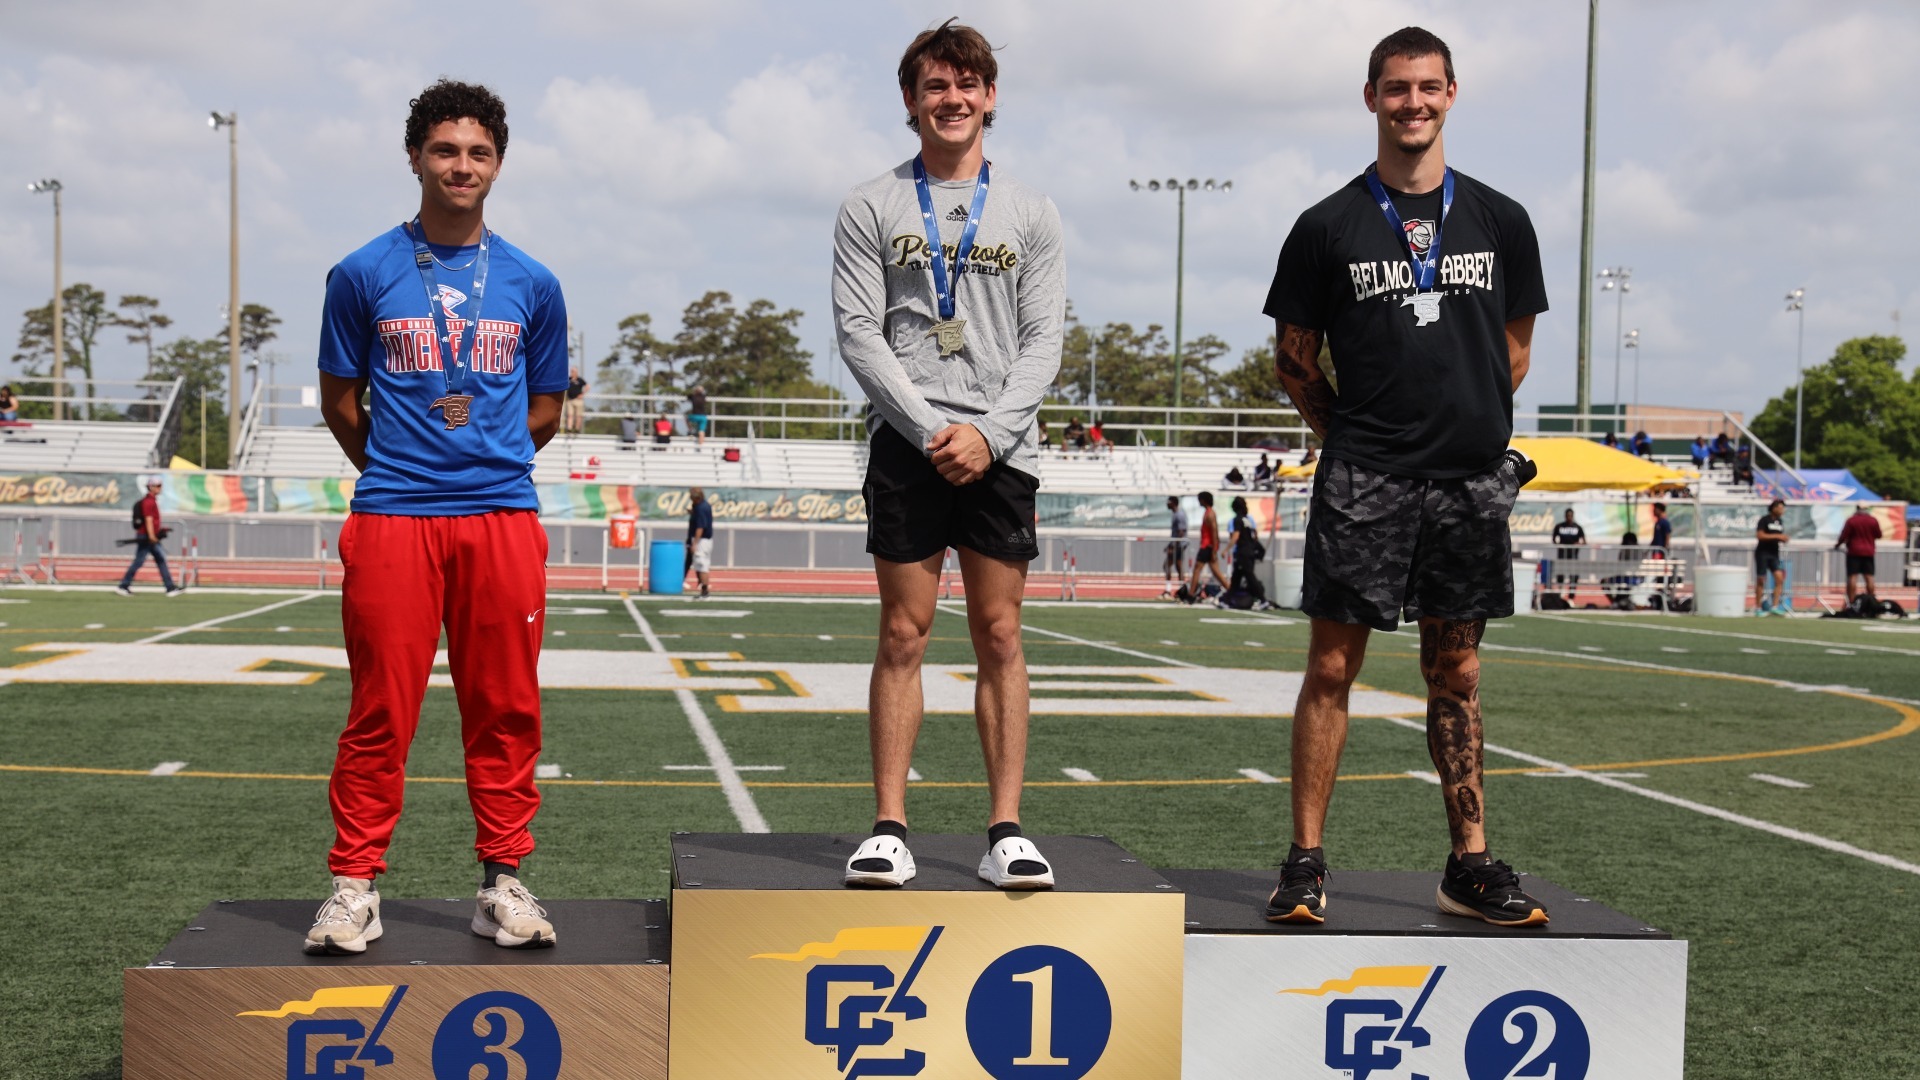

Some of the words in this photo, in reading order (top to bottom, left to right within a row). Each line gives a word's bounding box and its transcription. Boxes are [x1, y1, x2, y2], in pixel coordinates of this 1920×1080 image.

[1349, 260, 1417, 302] BELMO
[1440, 252, 1494, 290] ABBEY
[381, 321, 402, 332] KING
[472, 333, 518, 374] FIELD
[33, 476, 120, 504] Beach
[771, 494, 794, 518] to
[797, 493, 841, 519] The
[1508, 507, 1555, 532] each
[1007, 535, 1033, 544] adidas
[1012, 965, 1069, 1066] 1
[468, 1006, 528, 1080] 3
[1502, 1005, 1557, 1080] 2
